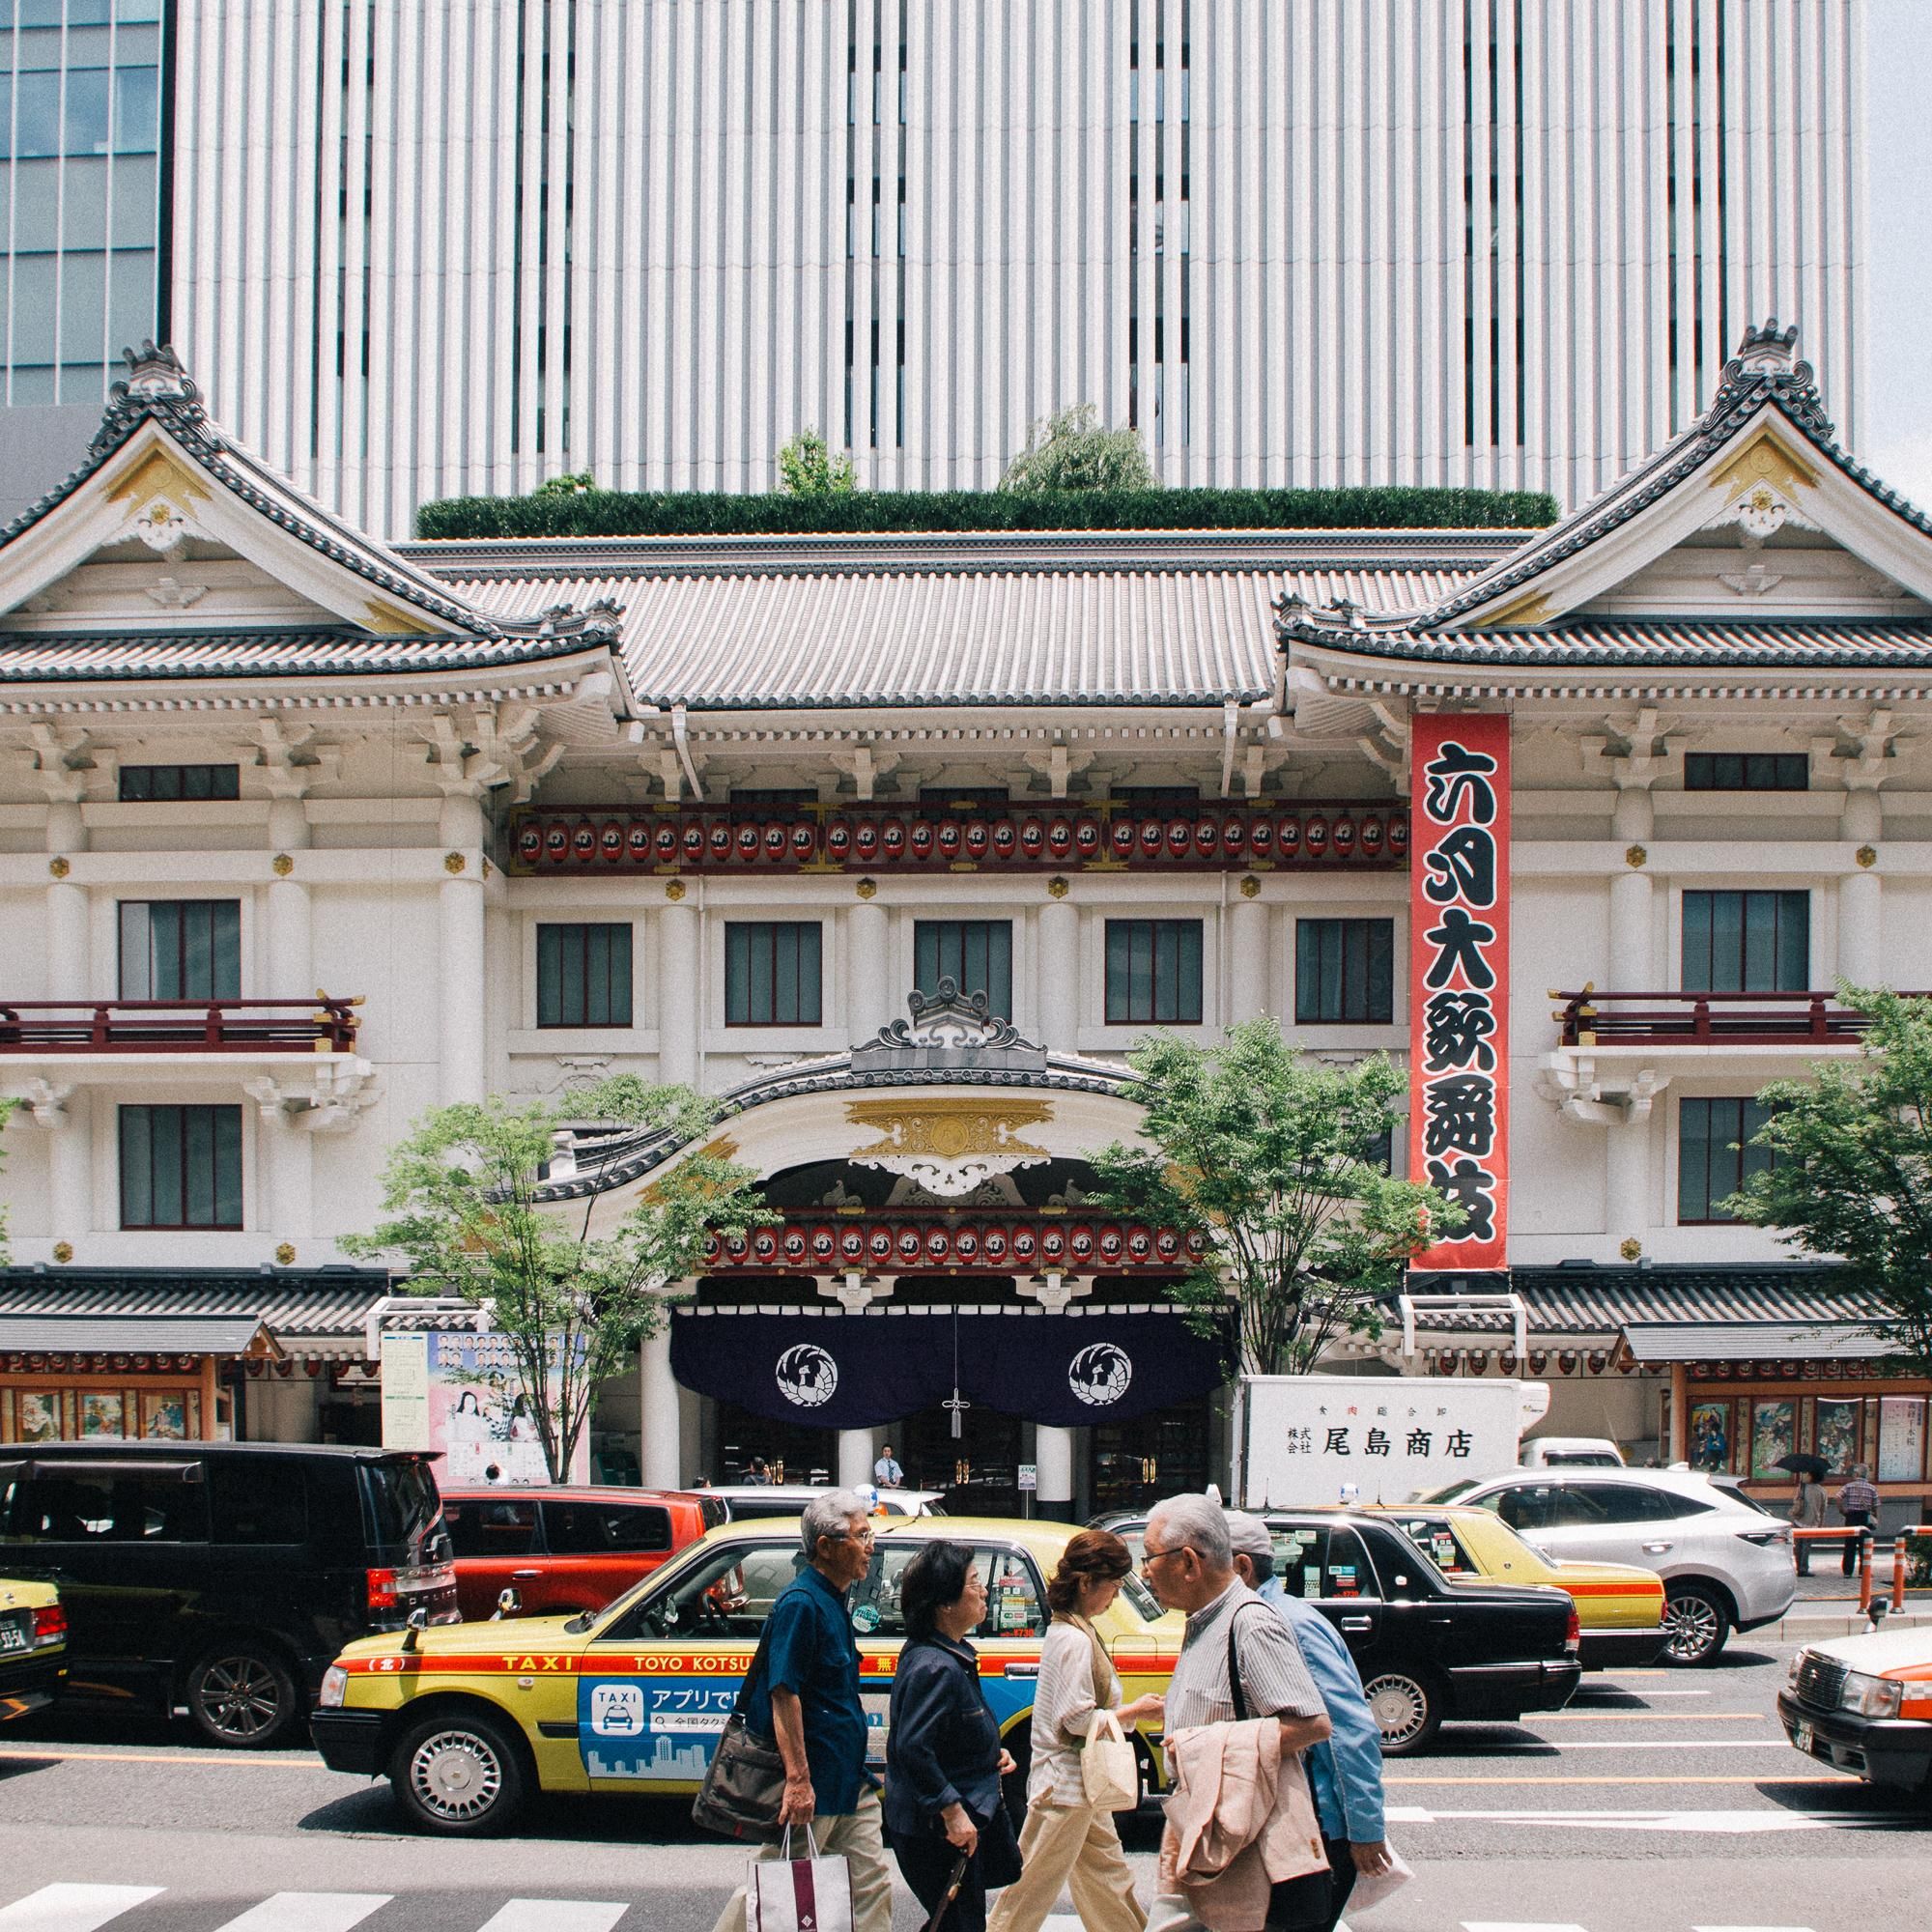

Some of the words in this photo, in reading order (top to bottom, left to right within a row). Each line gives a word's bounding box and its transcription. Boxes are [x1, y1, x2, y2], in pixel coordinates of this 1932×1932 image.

[1323, 1427, 1474, 1458] 尾島商店
[502, 1656, 572, 1670] TAXI
[634, 1657, 683, 1671] TOYO
[693, 1657, 751, 1671] KOTSU
[599, 1692, 637, 1703] TAXI
[652, 1690, 740, 1710] アプリで
